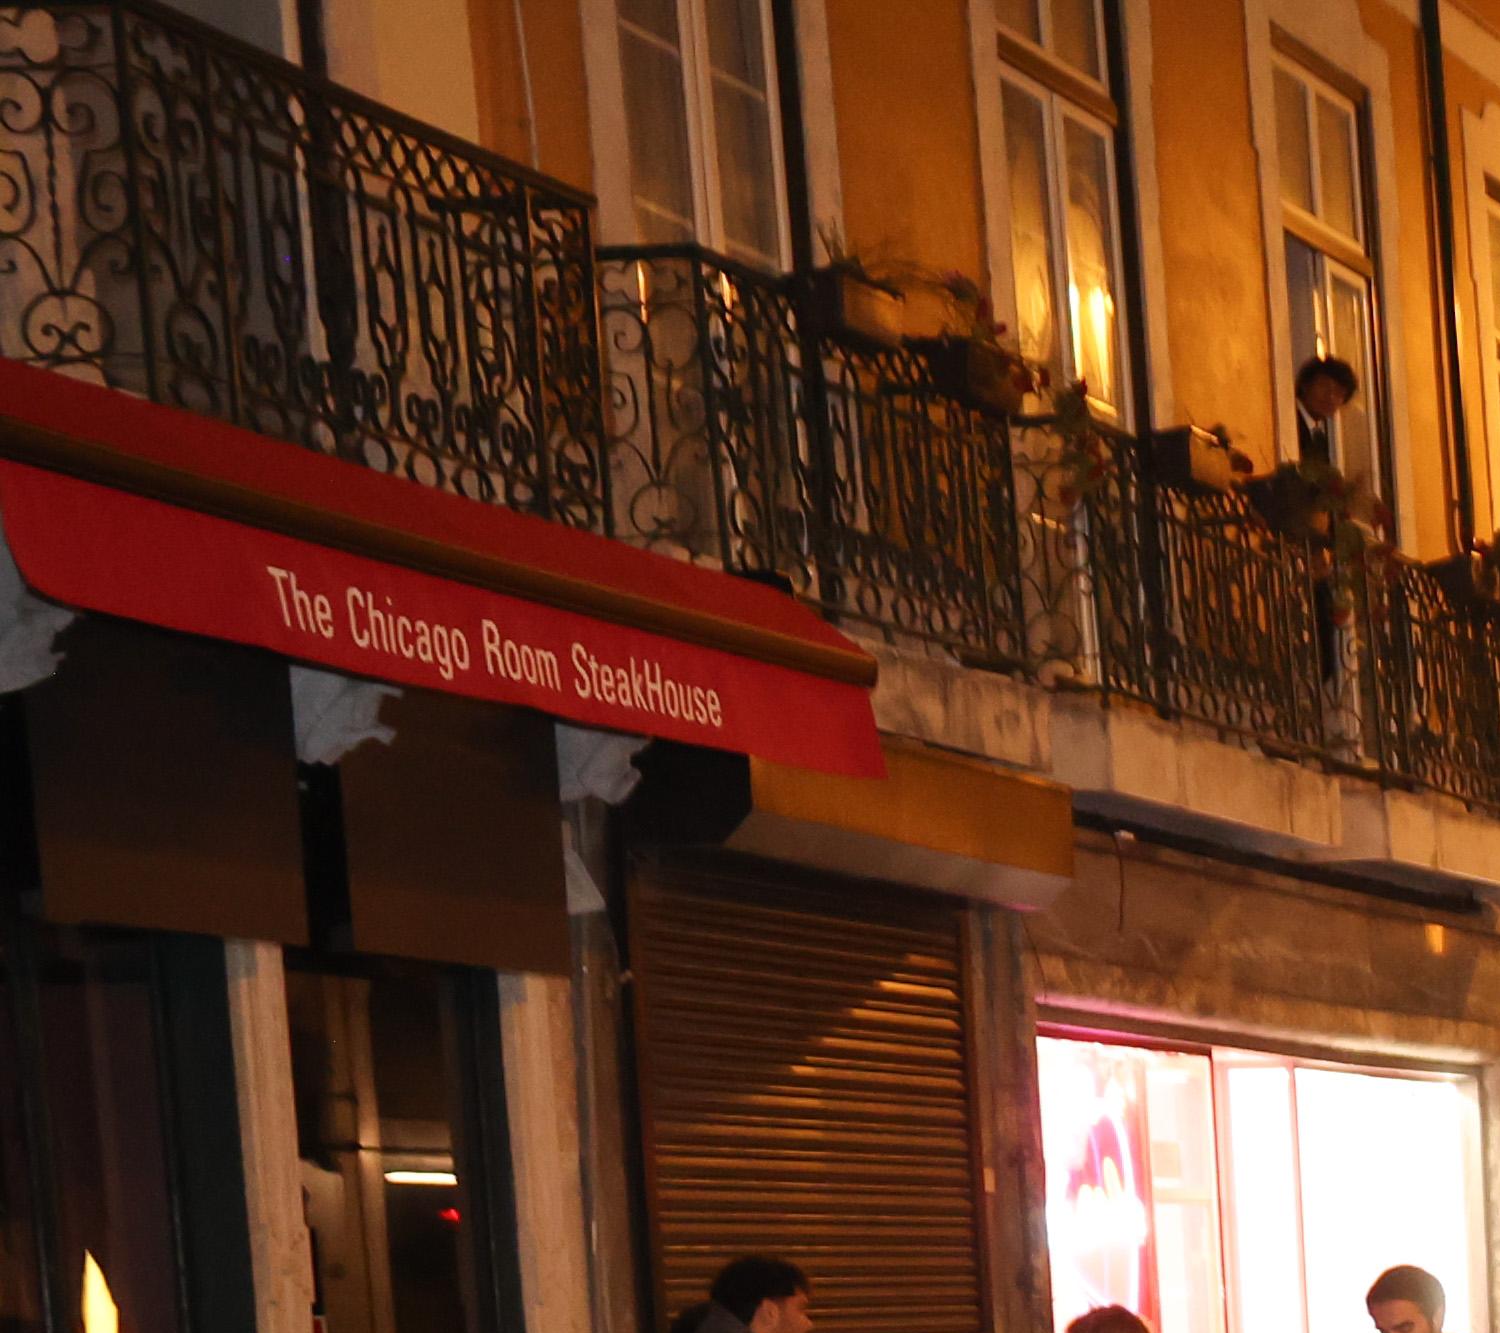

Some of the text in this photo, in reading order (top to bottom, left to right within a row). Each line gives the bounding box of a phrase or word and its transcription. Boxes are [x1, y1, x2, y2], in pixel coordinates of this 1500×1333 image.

[267, 565, 723, 728] The Chicago Room SteakHouse
